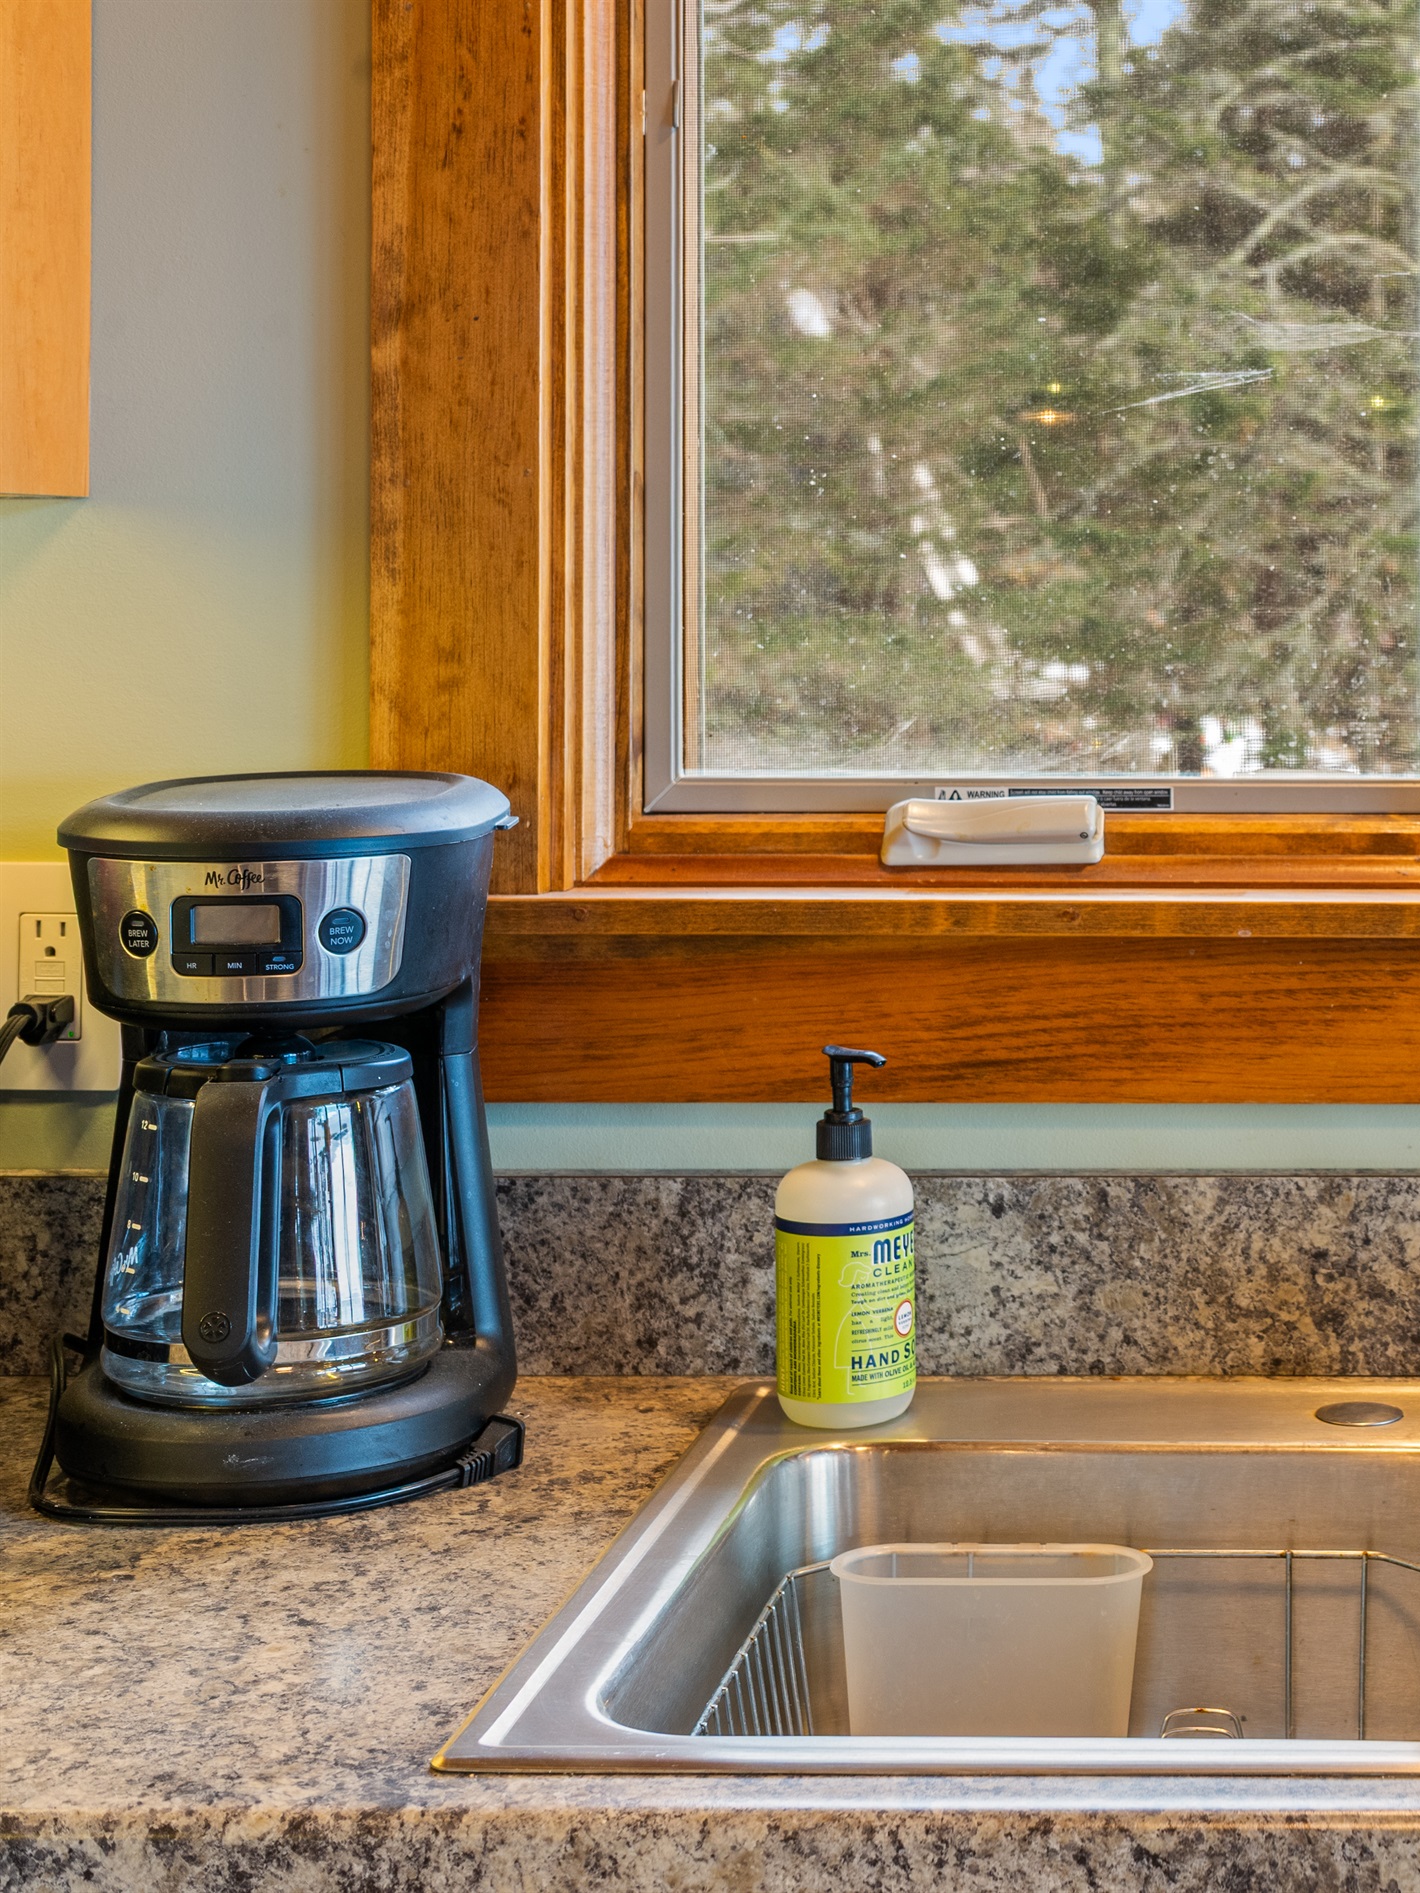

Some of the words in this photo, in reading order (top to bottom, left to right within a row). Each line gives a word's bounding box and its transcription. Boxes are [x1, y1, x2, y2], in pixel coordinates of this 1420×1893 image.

[205, 870, 226, 888] Mr.
[227, 869, 266, 890] Coffee
[128, 929, 148, 938] BREW
[329, 926, 354, 936] BREW
[128, 940, 150, 948] LATER
[330, 936, 353, 946] NOW
[227, 962, 243, 970] MIN
[265, 963, 295, 971] STRONG
[141, 1120, 148, 1130] 12
[849, 1219, 903, 1232] HARDWORKING
[851, 1250, 871, 1258] Mrs.
[851, 1350, 899, 1370] HAND
[852, 1374, 868, 1382] MADE
[870, 1372, 883, 1380] WITH
[885, 1367, 901, 1377] OLIVE
